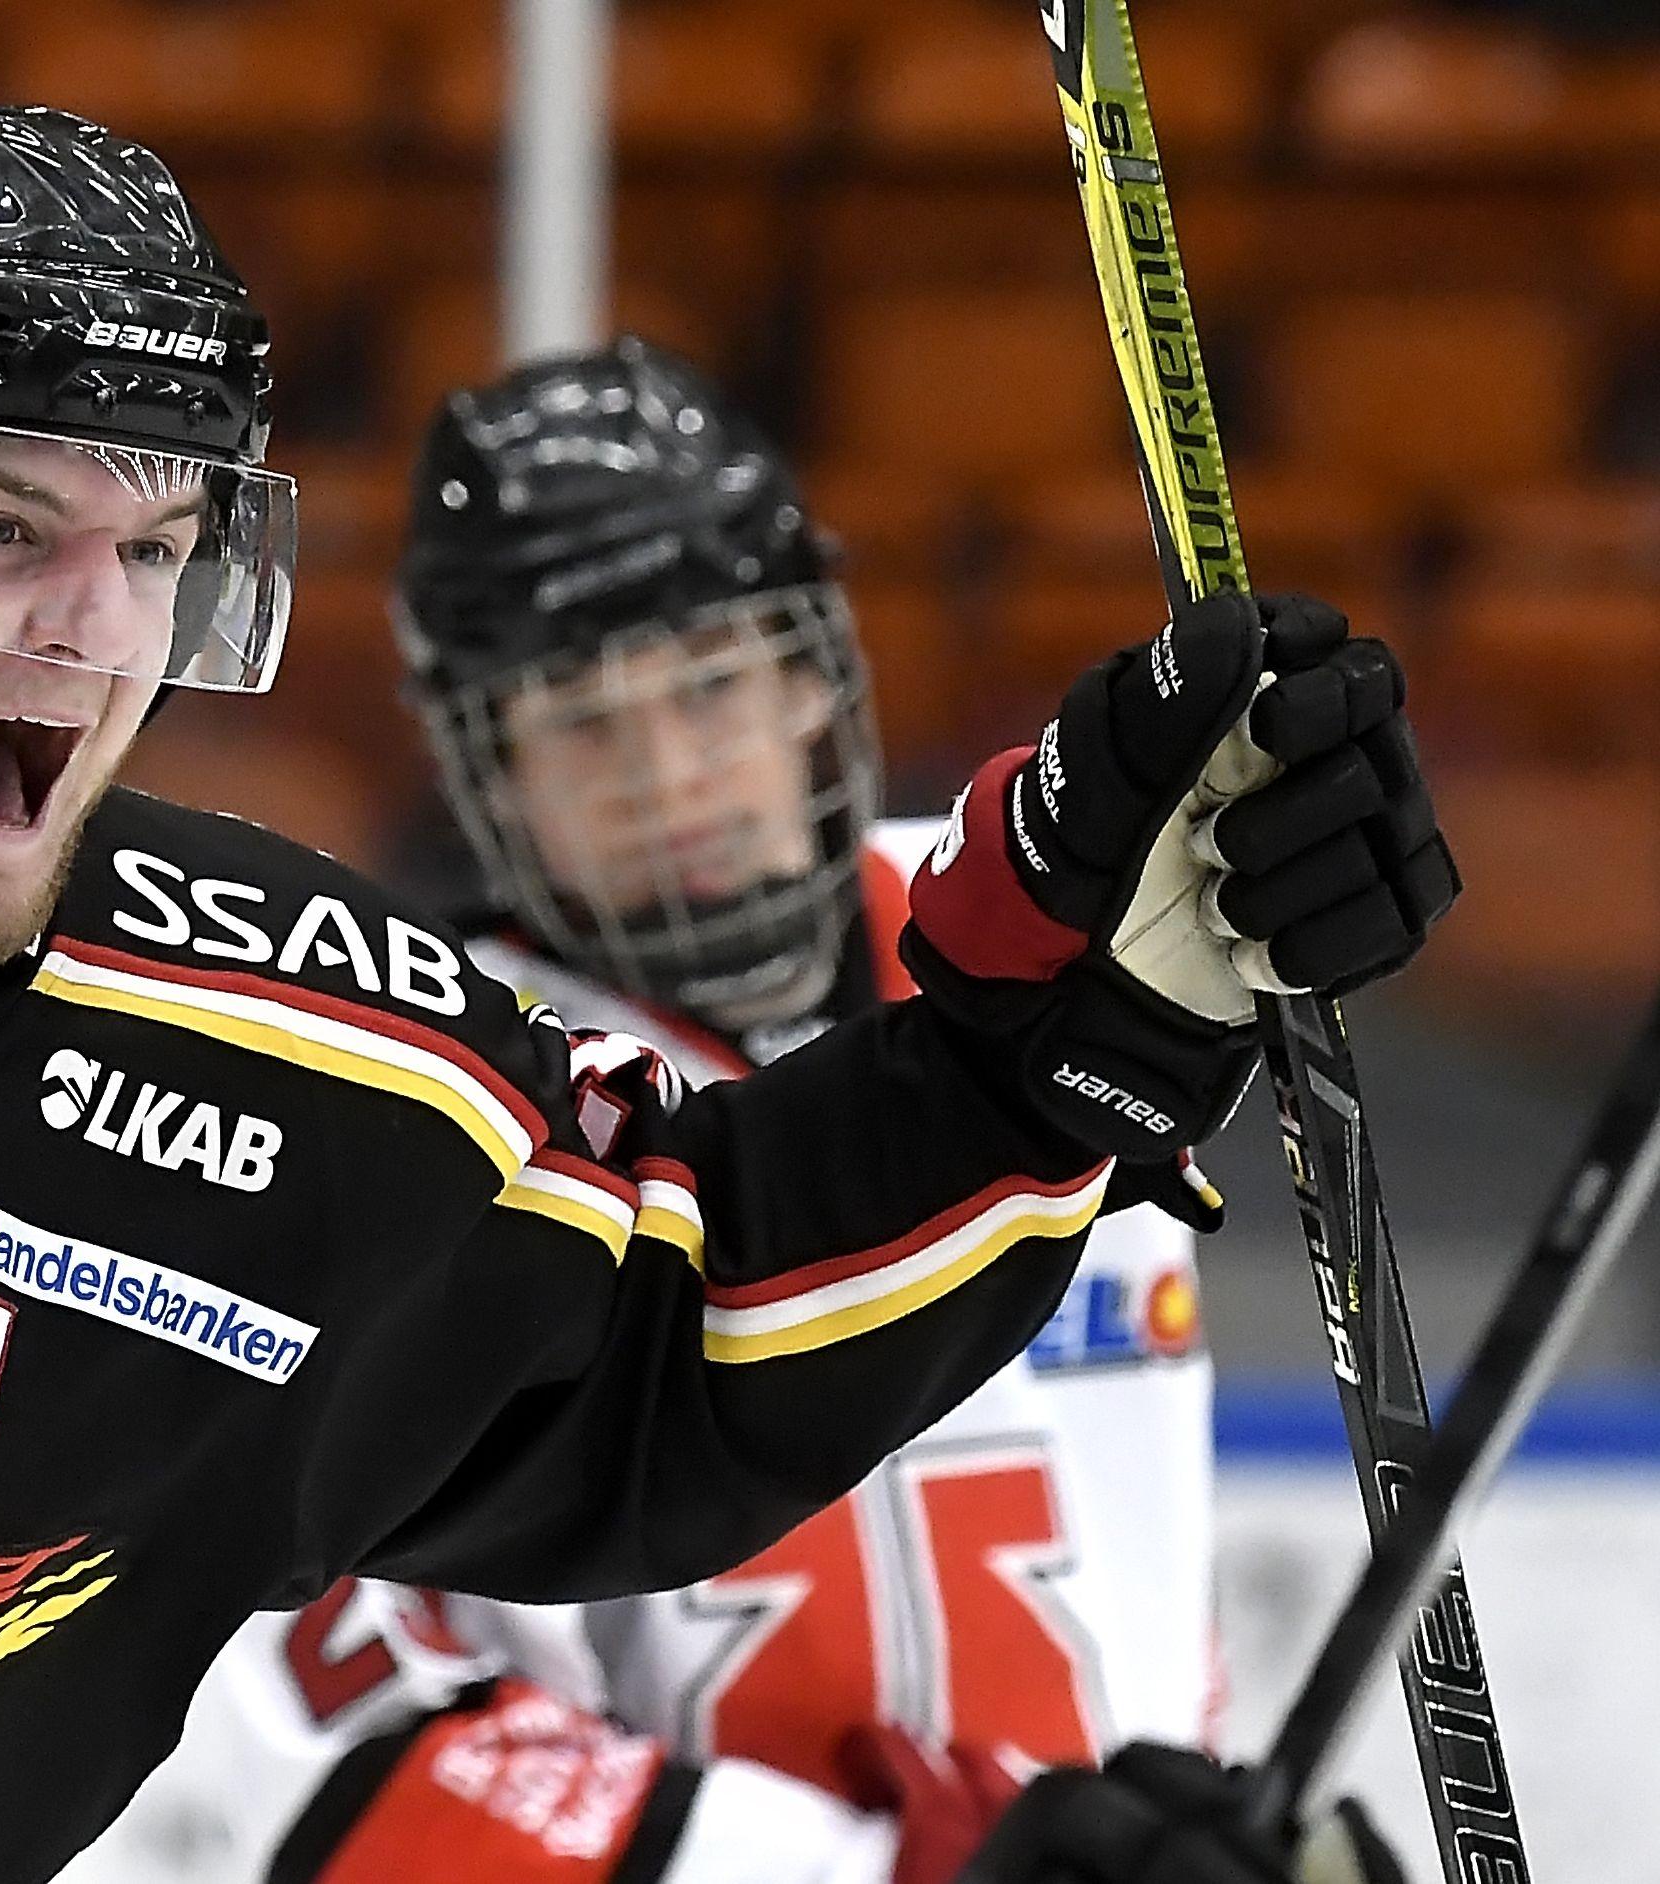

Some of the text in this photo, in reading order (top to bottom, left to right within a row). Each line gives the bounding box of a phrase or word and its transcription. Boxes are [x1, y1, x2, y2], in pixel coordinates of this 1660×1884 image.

[84, 320, 227, 366] BAUER
[112, 849, 466, 1017] SSAB
[87, 1070, 283, 1192] LKAB
[1052, 1062, 1175, 1134] BAUER
